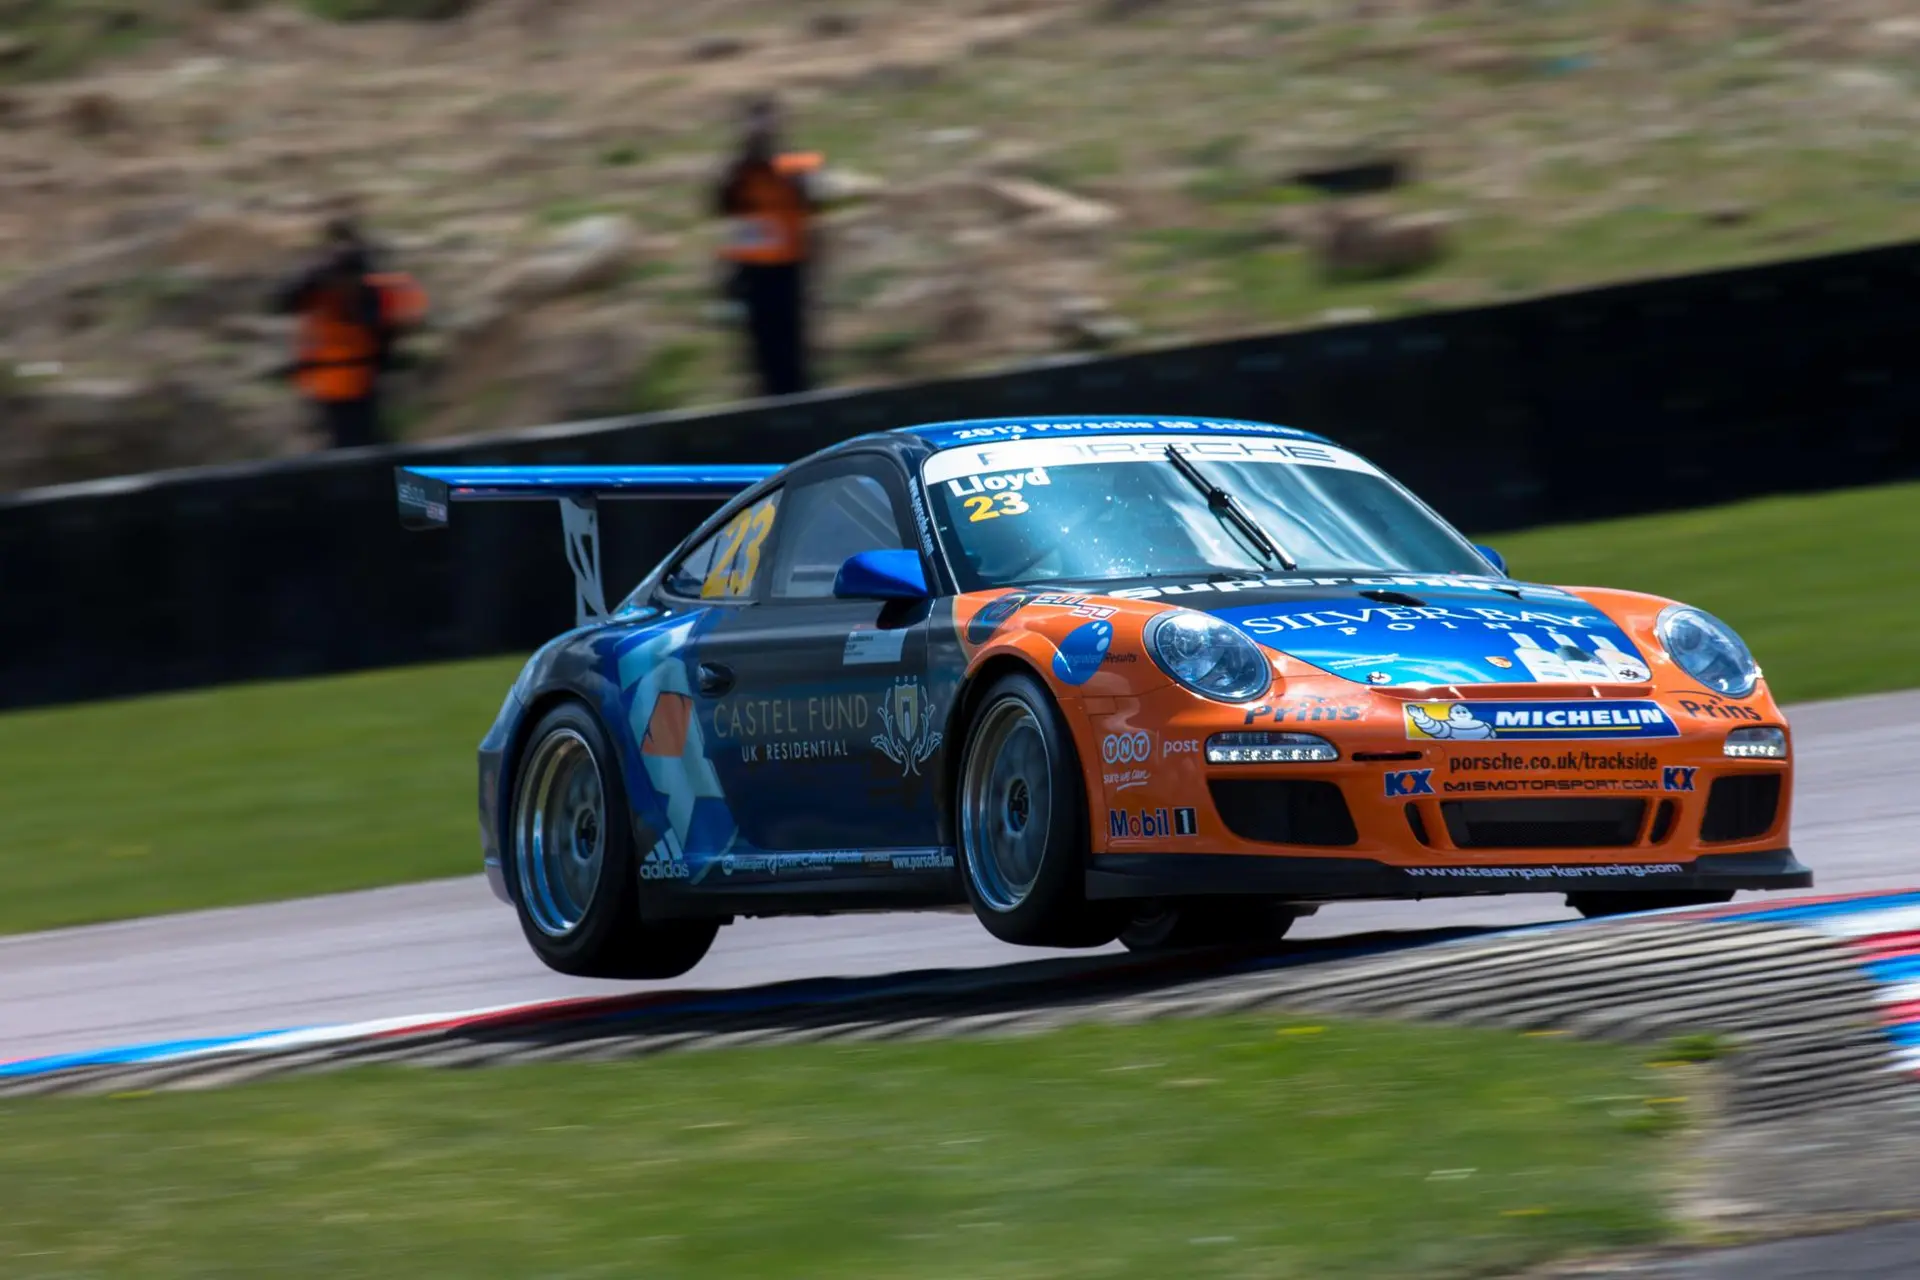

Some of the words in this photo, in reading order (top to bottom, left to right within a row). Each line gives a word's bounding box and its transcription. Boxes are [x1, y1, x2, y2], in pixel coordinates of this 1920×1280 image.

[1030, 421, 1154, 431] Porsche
[976, 438, 1337, 467] PRSCHE
[947, 467, 1051, 497] Lloyd
[963, 492, 1029, 522] 23
[701, 503, 776, 599] 23
[1242, 605, 1467, 634] SILVER
[1465, 607, 1598, 629] BAY
[1337, 618, 1556, 636] POINT
[1105, 652, 1138, 664] Results
[713, 699, 798, 738] CASTEL
[808, 694, 868, 731] FUND
[1244, 702, 1360, 725] Prins
[1495, 709, 1665, 726] MICHELIN
[1678, 698, 1762, 721] Prins
[741, 745, 758, 763] UK
[766, 739, 848, 760] RESIDENTIAL
[1105, 736, 1148, 760] TNT
[1163, 739, 1199, 758] post
[1450, 752, 1658, 773] porsche.co.uk/trackside
[1384, 768, 1435, 797] KX
[1662, 766, 1700, 792] KX
[1109, 808, 1170, 838] Mobil
[640, 860, 690, 880] adidas
[1404, 863, 1683, 880] www.teamparkerracing.com
